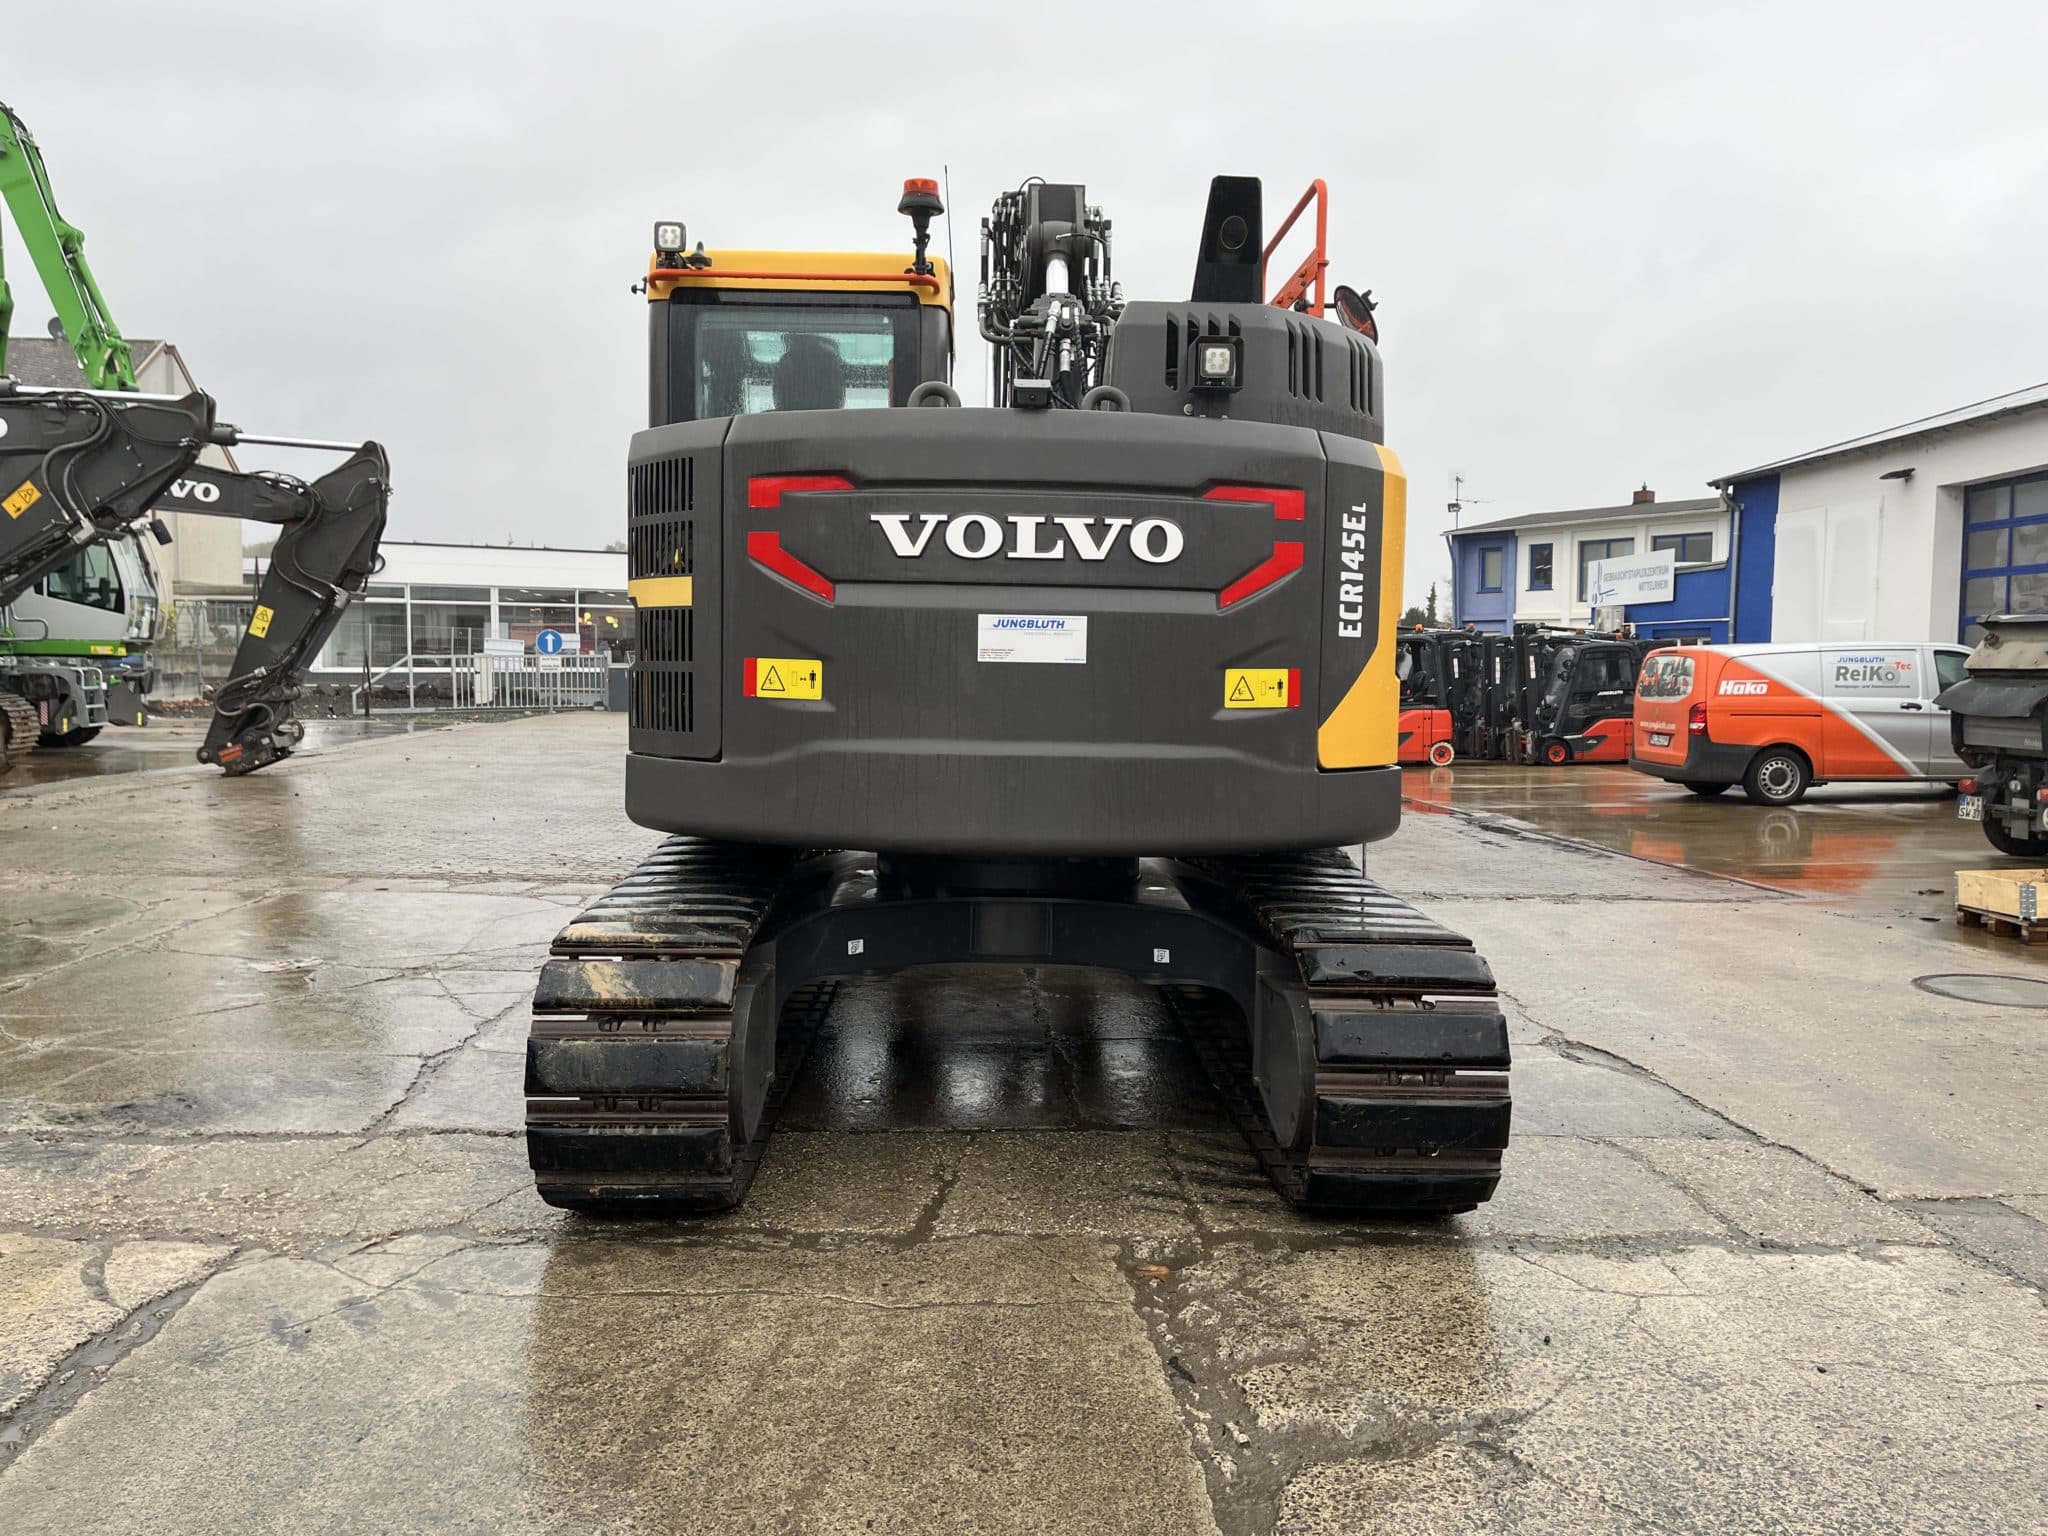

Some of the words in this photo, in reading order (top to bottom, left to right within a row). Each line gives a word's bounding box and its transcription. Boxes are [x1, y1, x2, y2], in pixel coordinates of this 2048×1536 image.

[870, 513, 1184, 564] VOLVO
[1338, 502, 1367, 638] ECR145EL
[993, 618, 1065, 629] JUNGBLUTH
[1719, 679, 1769, 696] Hako
